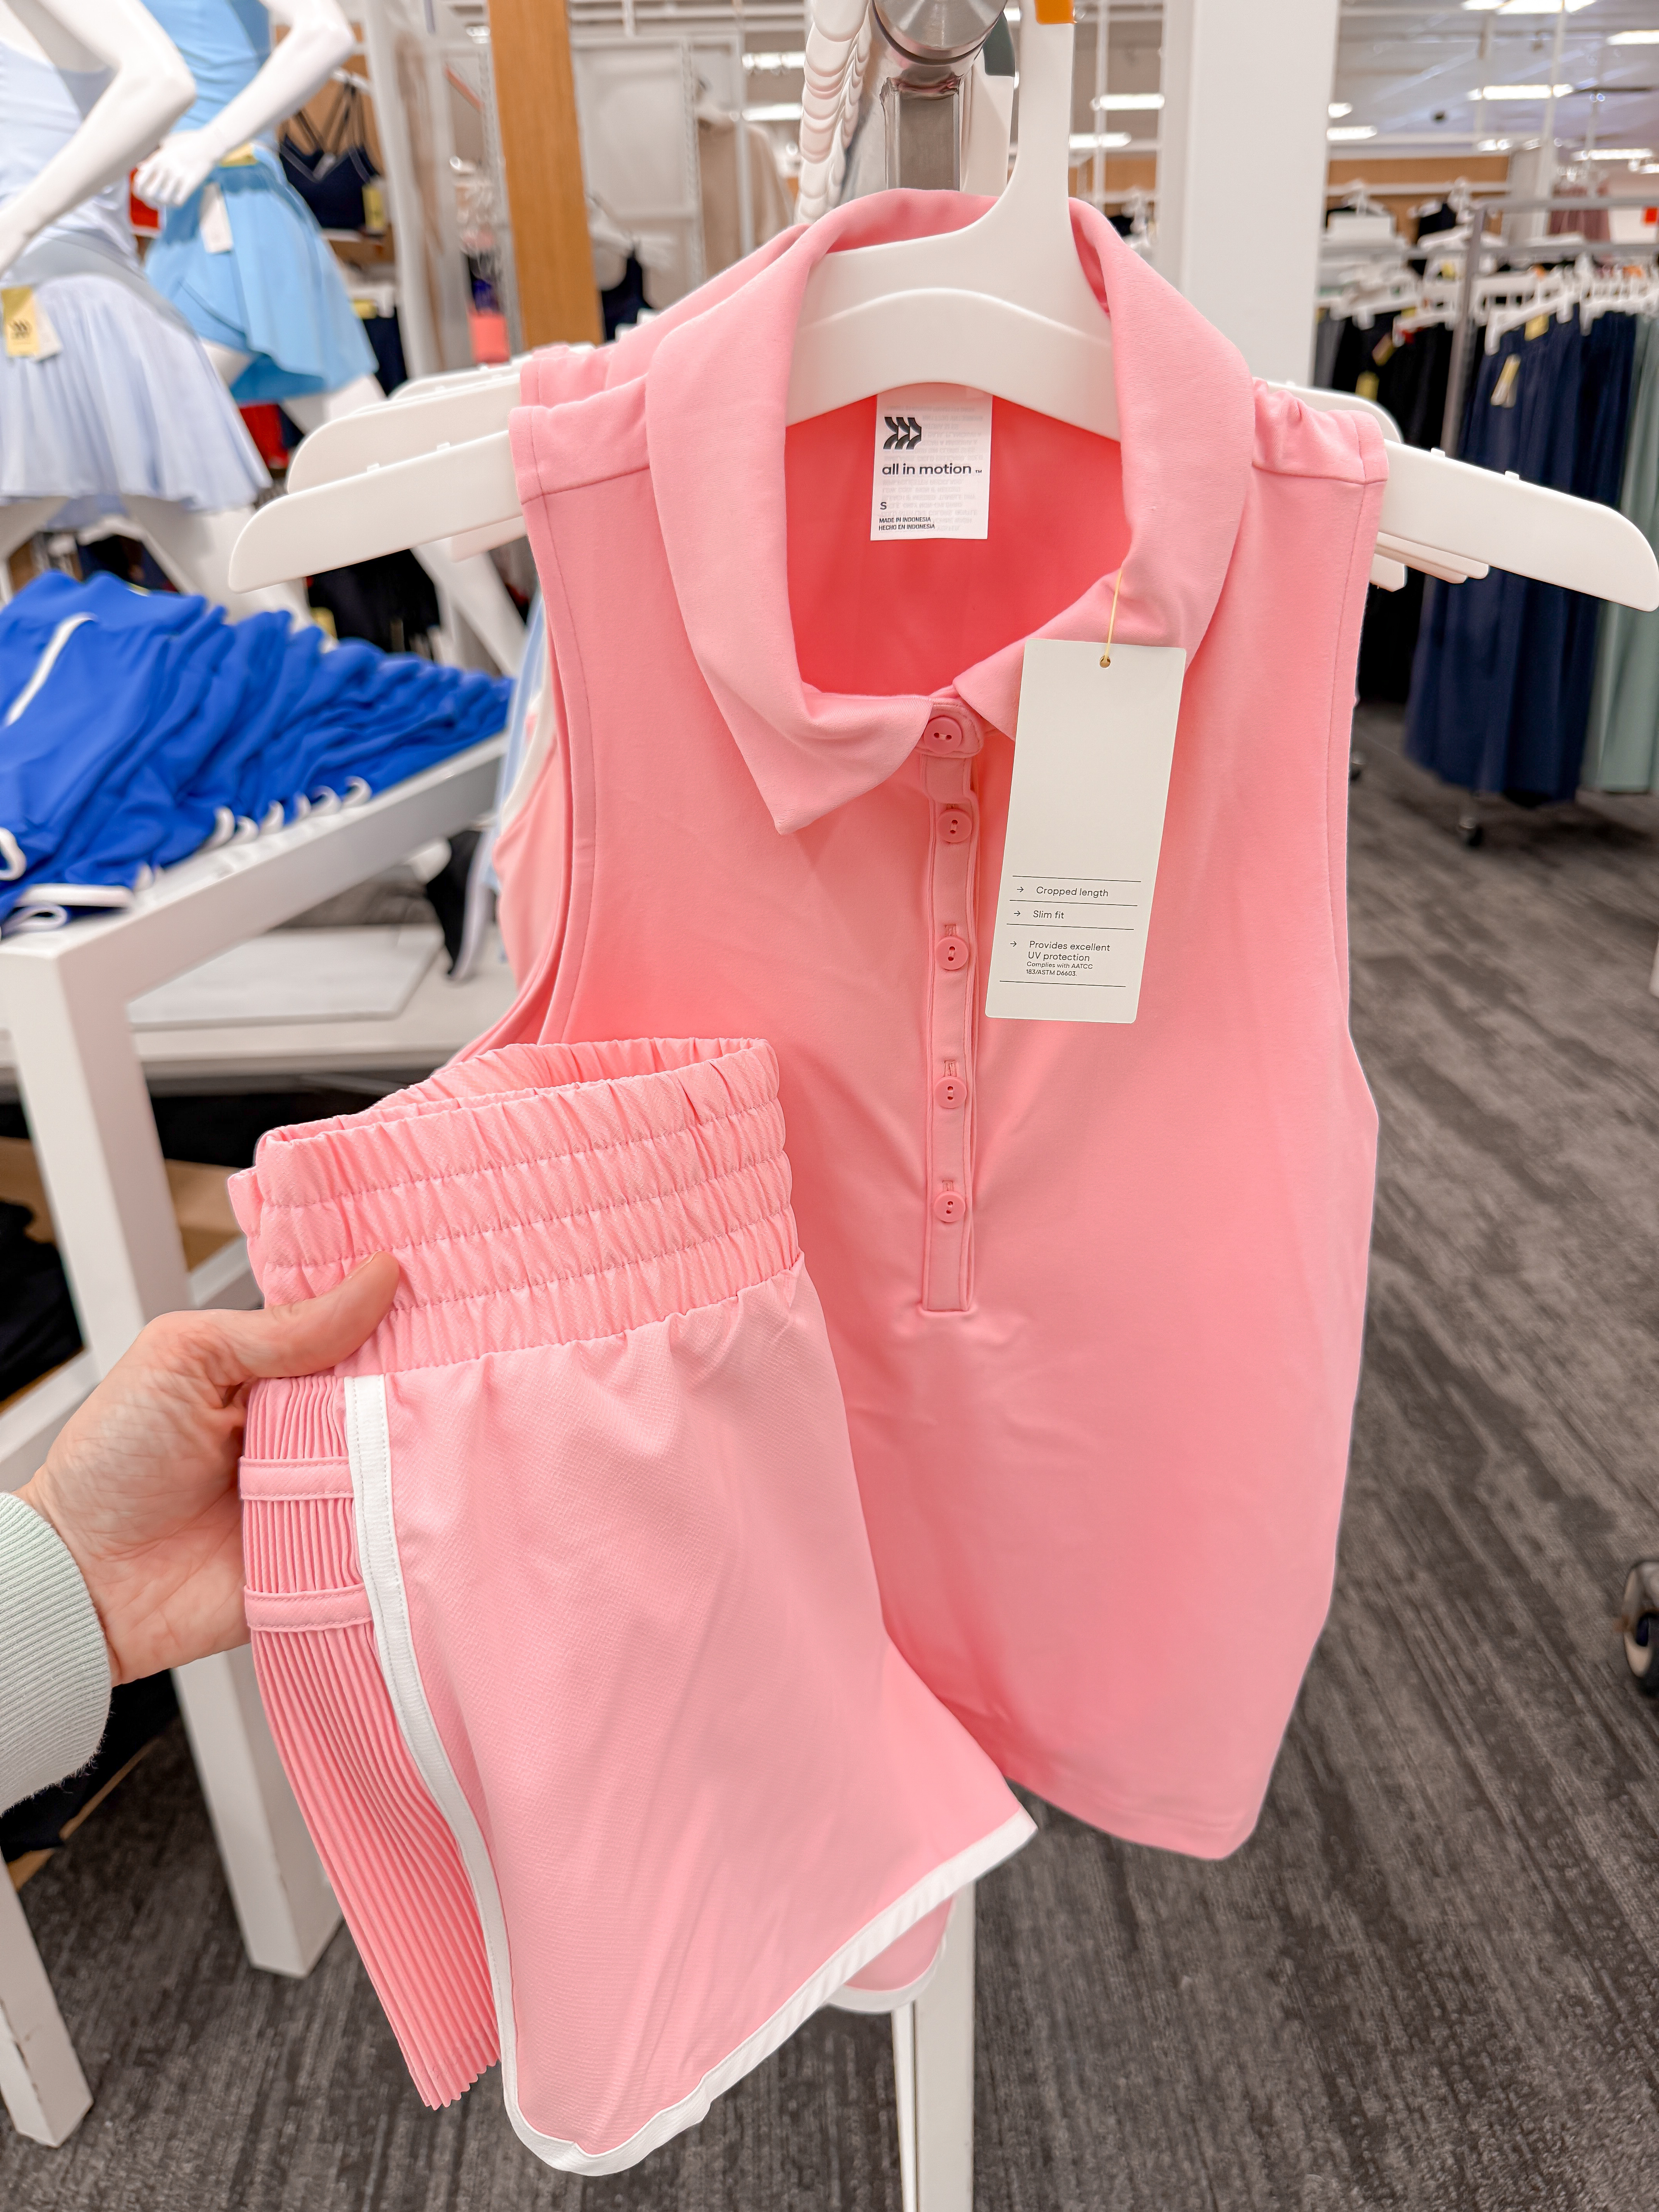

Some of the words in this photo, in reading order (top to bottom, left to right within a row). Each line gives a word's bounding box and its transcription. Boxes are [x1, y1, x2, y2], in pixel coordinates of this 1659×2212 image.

[882, 463, 899, 475] all
[903, 463, 915, 475] in
[919, 463, 972, 475] motion
[880, 501, 887, 510] S
[1036, 886, 1077, 896] Cropped
[1079, 888, 1108, 898] length
[1033, 910, 1052, 918] Slim
[1029, 941, 1067, 949] Provides
[1070, 943, 1110, 951] excellent
